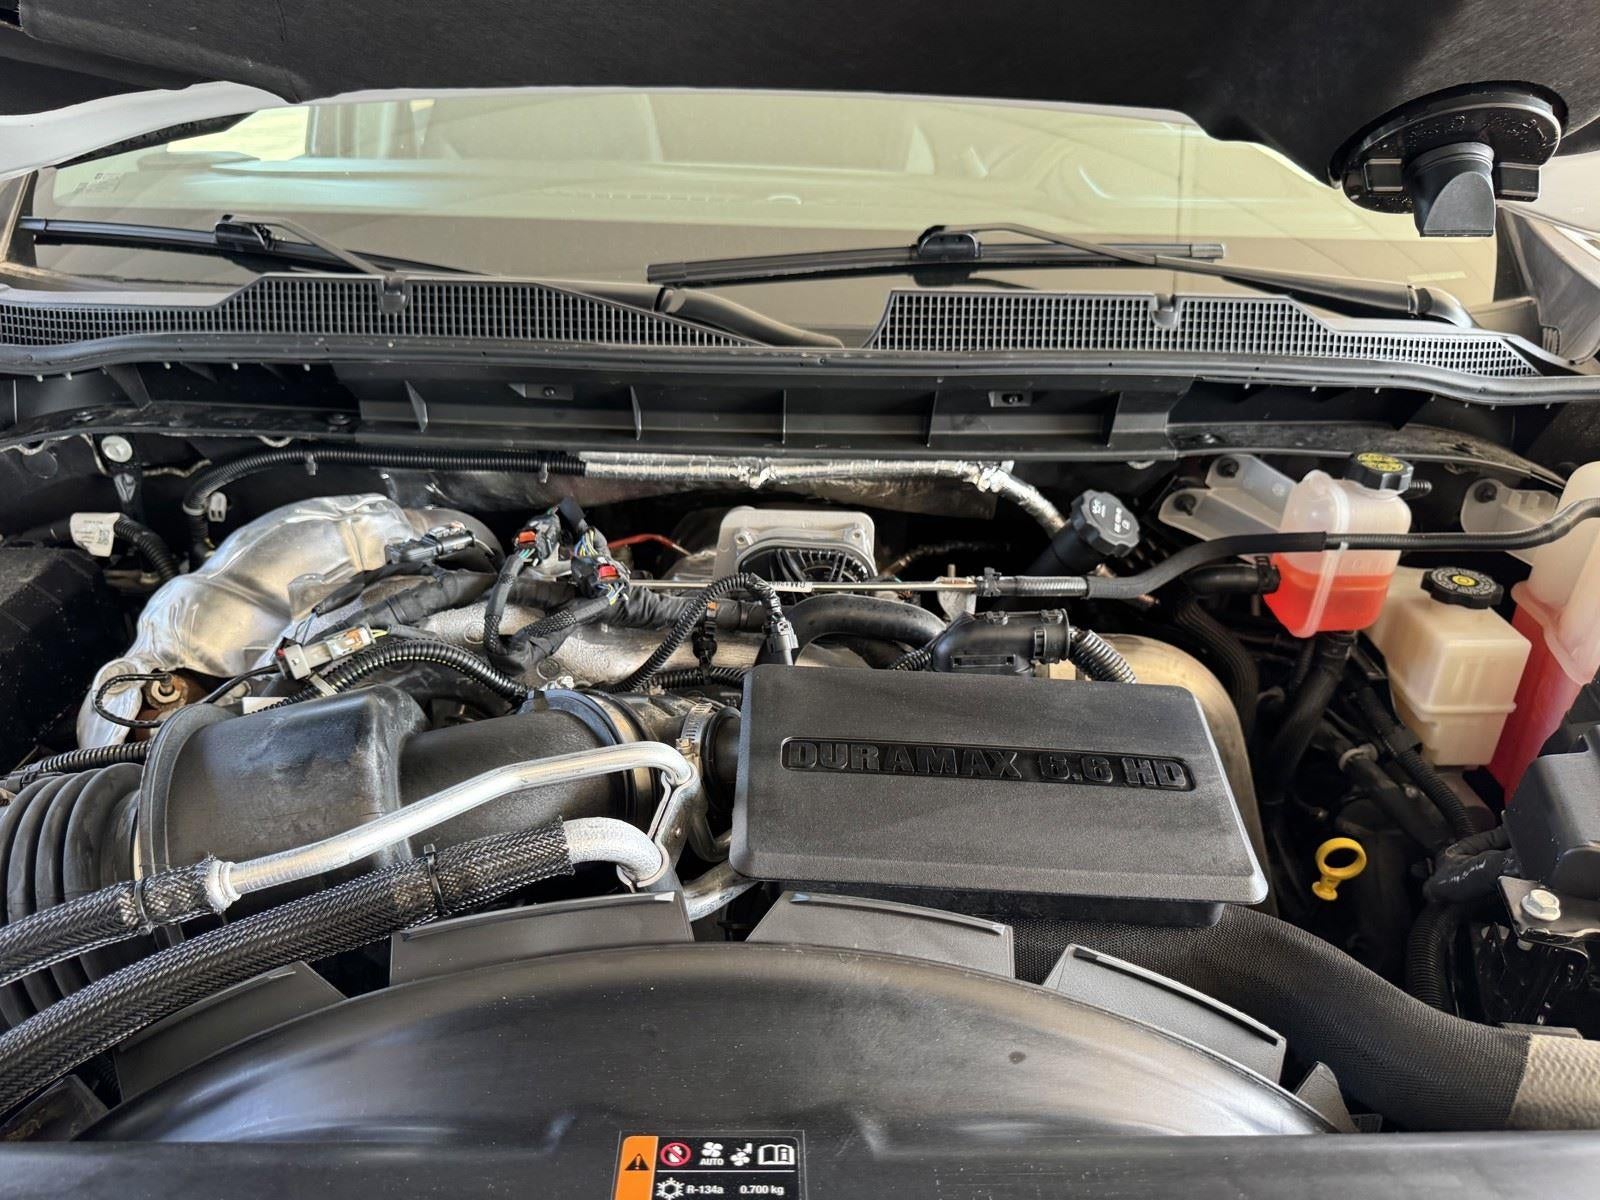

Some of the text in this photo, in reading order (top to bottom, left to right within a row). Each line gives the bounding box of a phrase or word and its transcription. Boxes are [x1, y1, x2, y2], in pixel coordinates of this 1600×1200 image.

[787, 742, 1187, 786] DURAMAX 6.6 HD
[699, 1157, 724, 1166] AUTO
[686, 1185, 785, 1196] R-134a 0.700 kg
